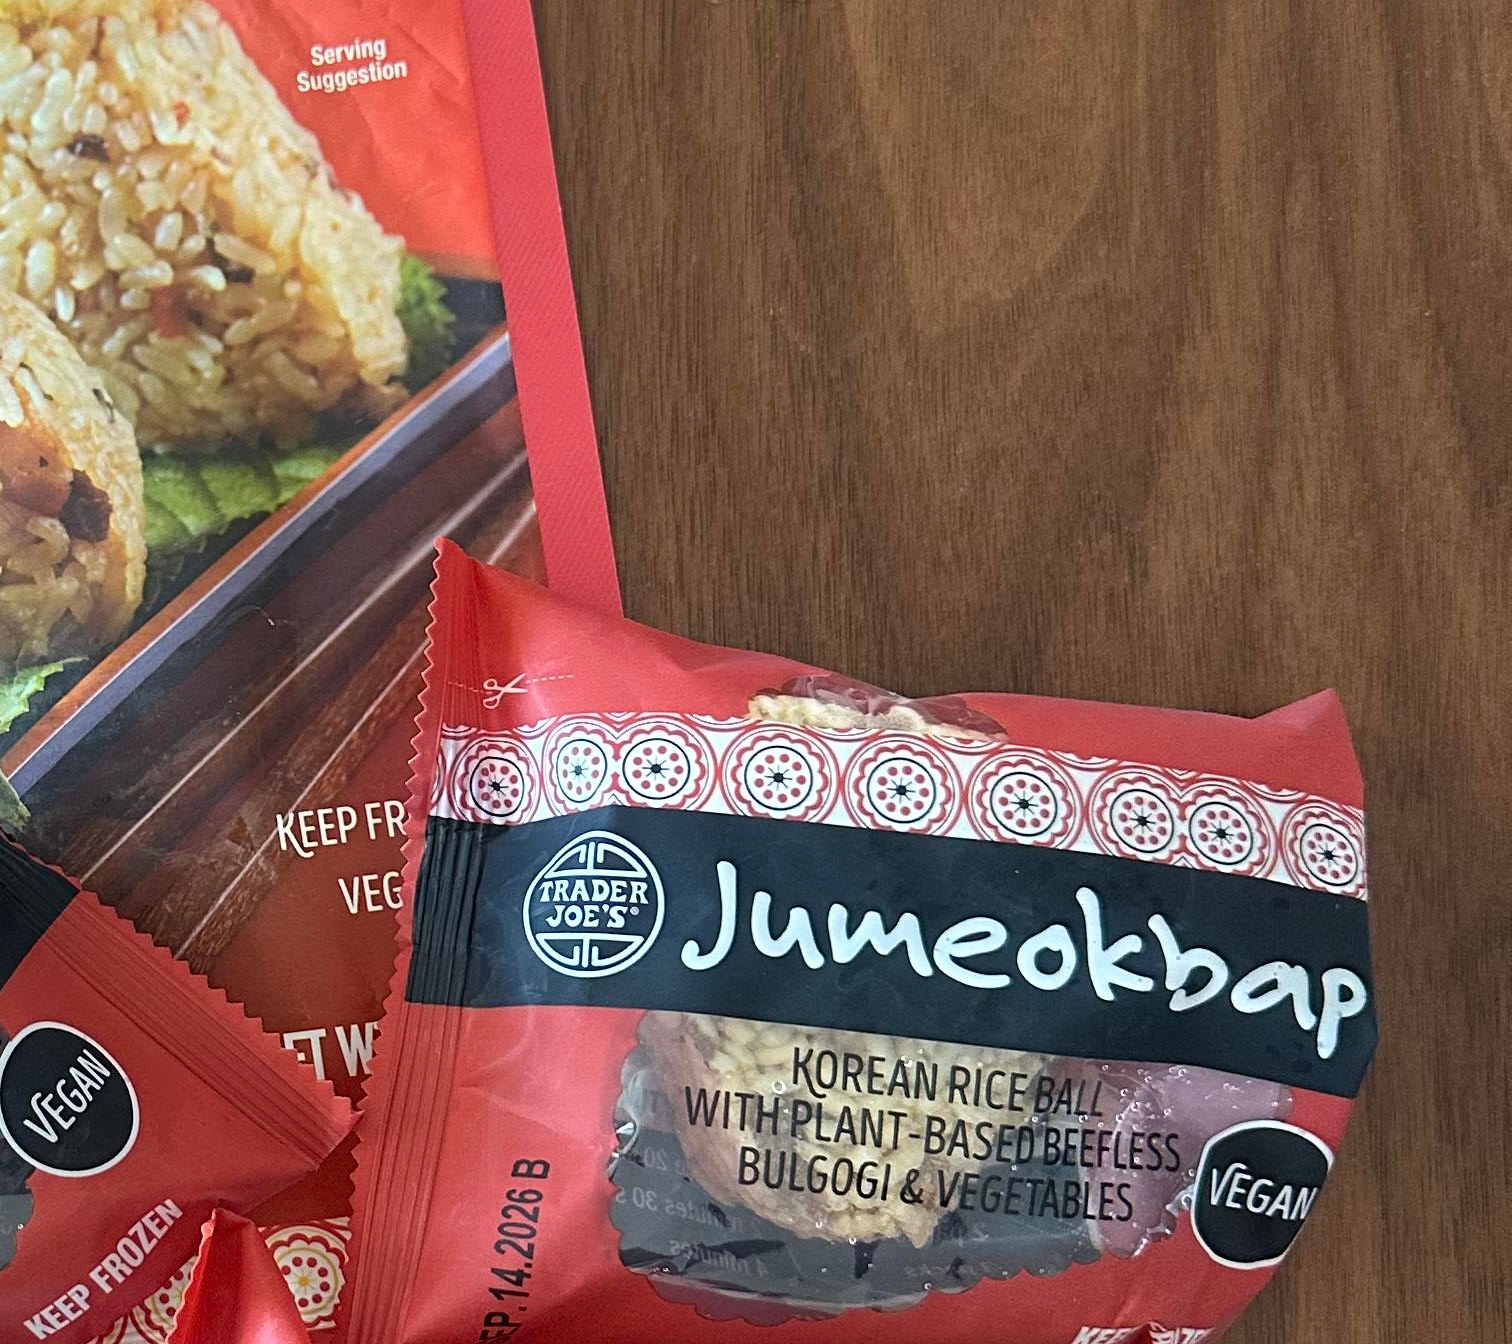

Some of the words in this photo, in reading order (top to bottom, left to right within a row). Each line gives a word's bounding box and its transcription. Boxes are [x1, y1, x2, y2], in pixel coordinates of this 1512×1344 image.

[296, 60, 409, 94] Suggestion
[310, 37, 388, 69] Serving
[275, 805, 359, 858] KEEP
[538, 879, 649, 907] TRADER
[682, 861, 1367, 1059] Jumeokbap
[22, 1049, 111, 1144] VEGAN
[792, 1046, 938, 1102] KOREAN
[949, 1068, 1027, 1113] RICE
[1032, 1074, 1104, 1119] BALL
[685, 1086, 779, 1134] WITH
[791, 1098, 1034, 1166] PLANT-BASED
[1046, 1125, 1181, 1173] BEEFLESS
[511, 1158, 551, 1179] B
[738, 1146, 891, 1203] BULGOGI
[899, 1170, 924, 1205] &
[937, 1170, 1134, 1223] VEGETABLES
[1210, 1163, 1321, 1222] VEGAN
[23, 1283, 91, 1340] KEEP
[90, 1198, 183, 1295] FROZEN
